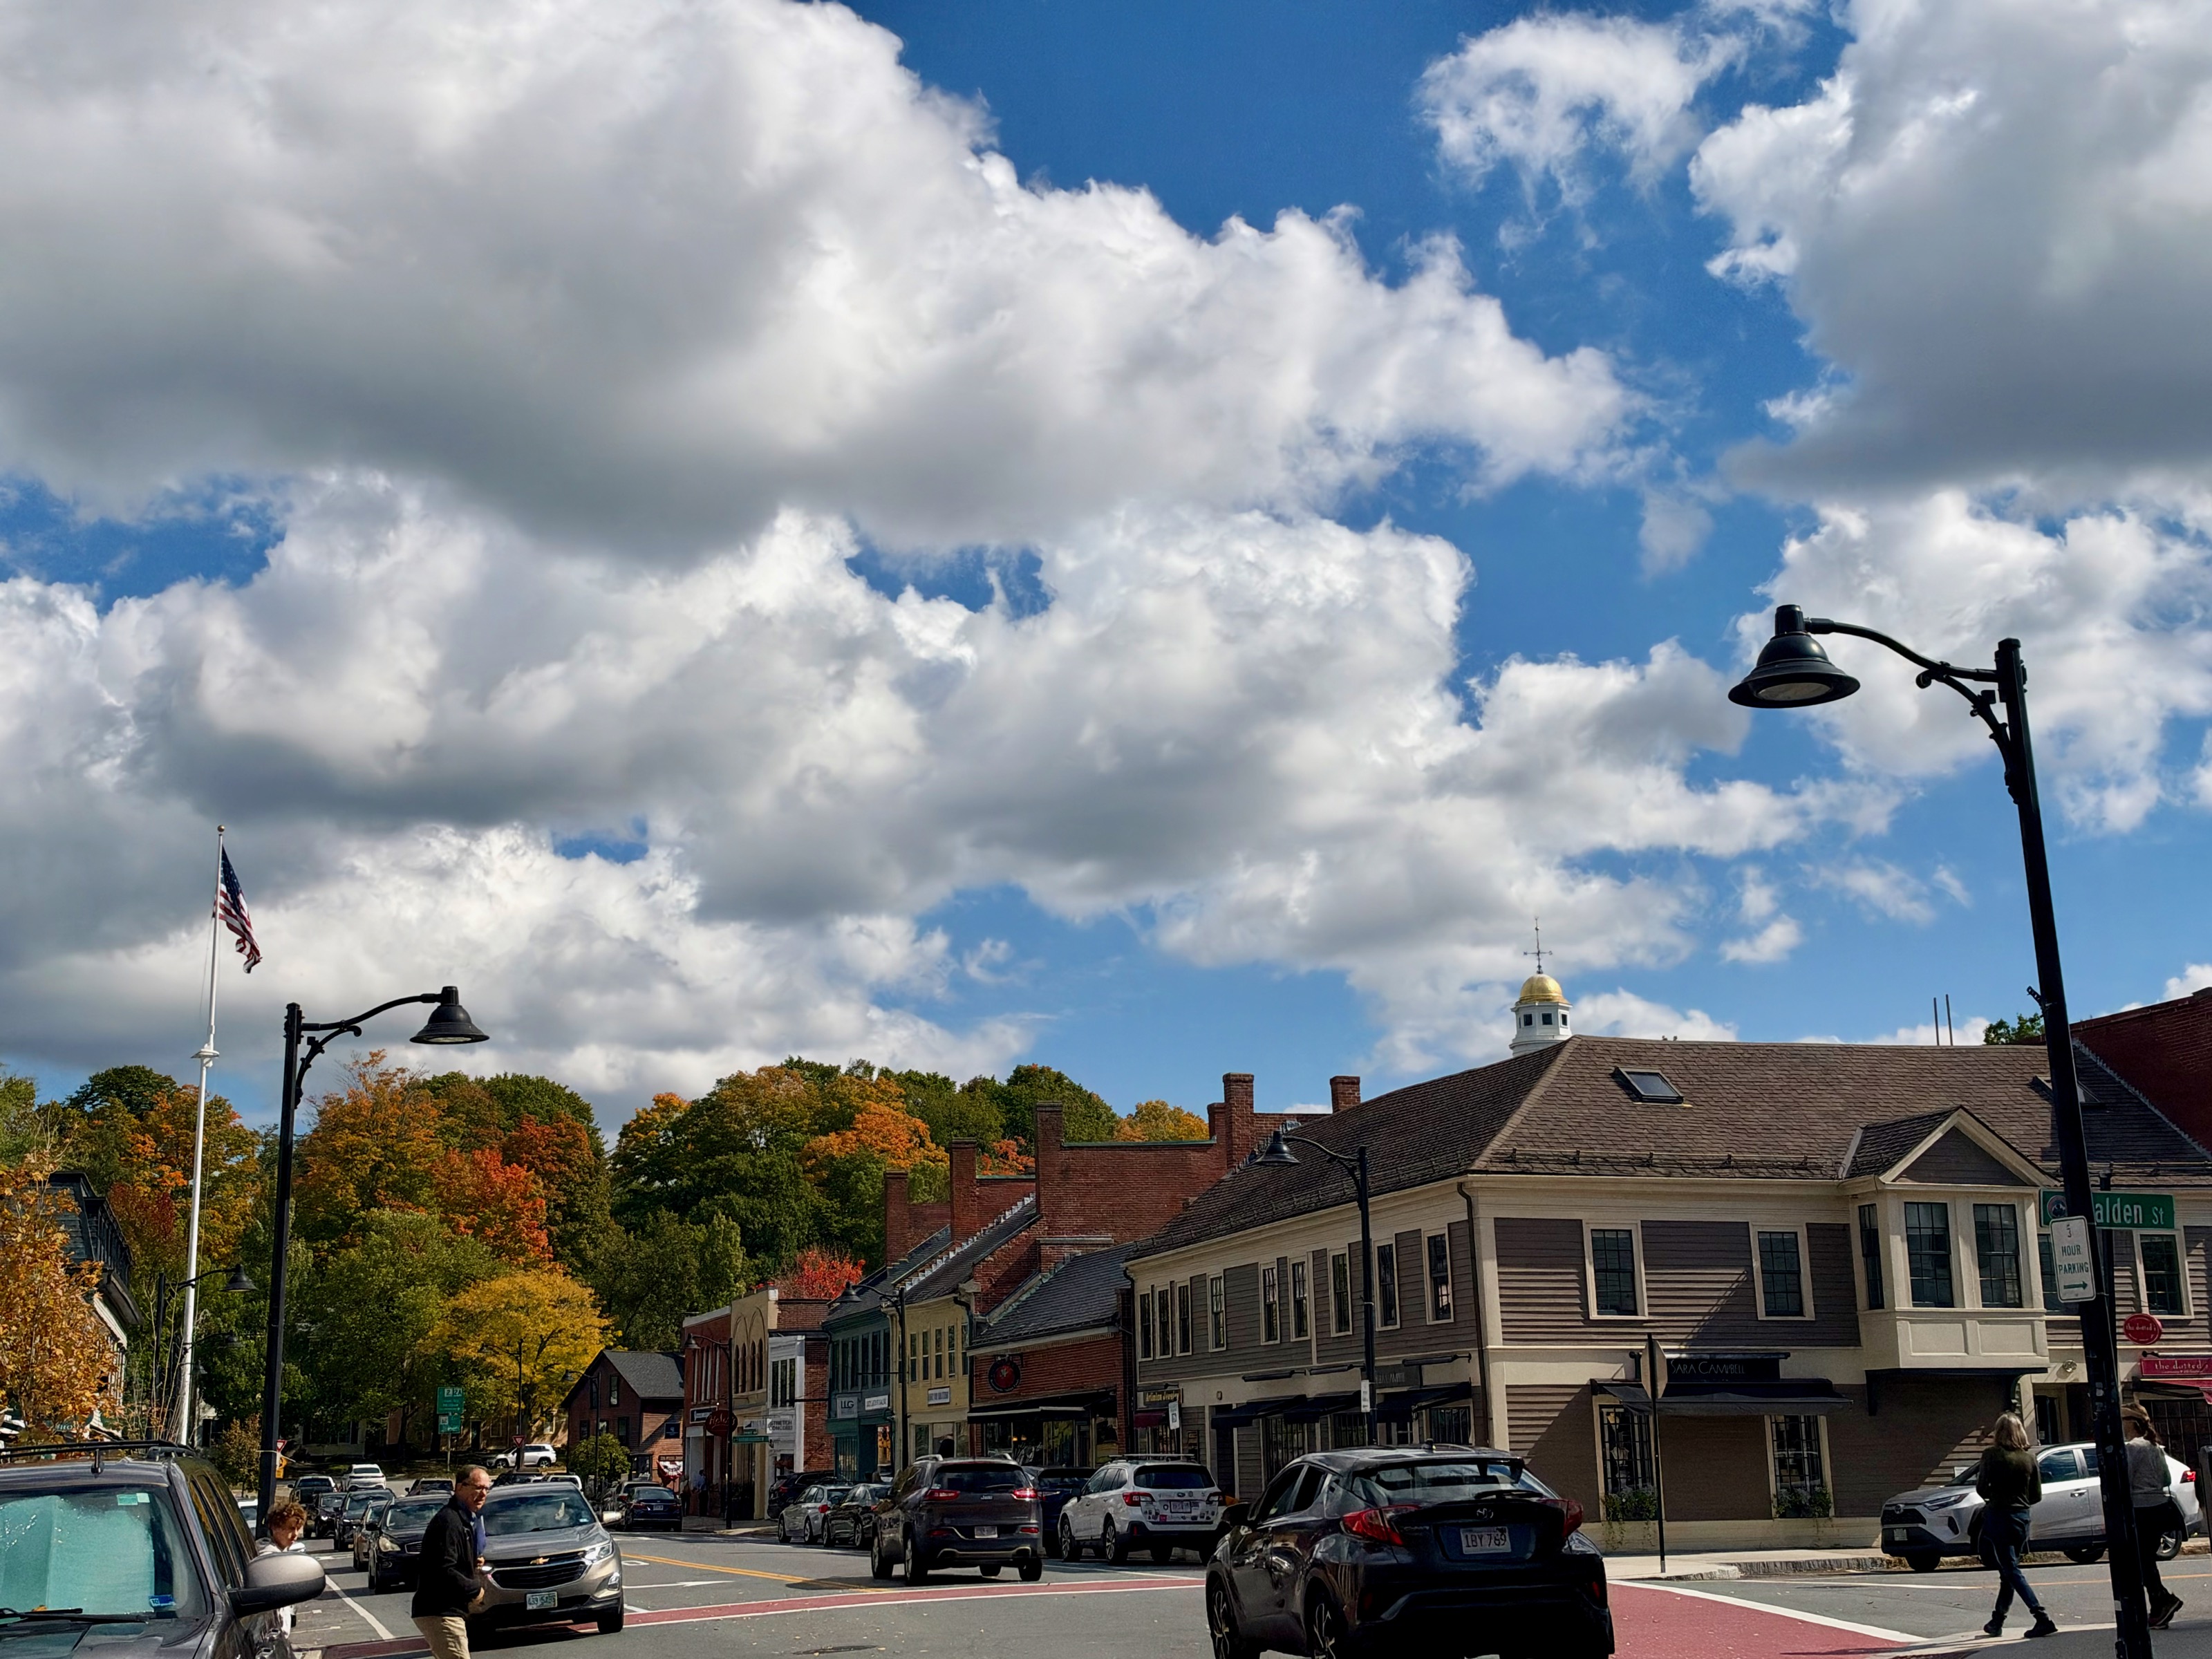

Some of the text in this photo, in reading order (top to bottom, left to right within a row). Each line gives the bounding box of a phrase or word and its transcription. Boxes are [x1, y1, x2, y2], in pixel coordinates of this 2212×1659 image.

[2094, 1197, 2164, 1224] alden St
[2061, 1244, 2081, 1257] HOUR
[2058, 1262, 2090, 1275] PARKING
[2136, 1322, 2153, 1331] dotted
[2155, 1360, 2170, 1369] the
[2173, 1360, 2202, 1369] dotted
[841, 1400, 854, 1409] LLG
[1465, 1534, 1483, 1548] 1BY
